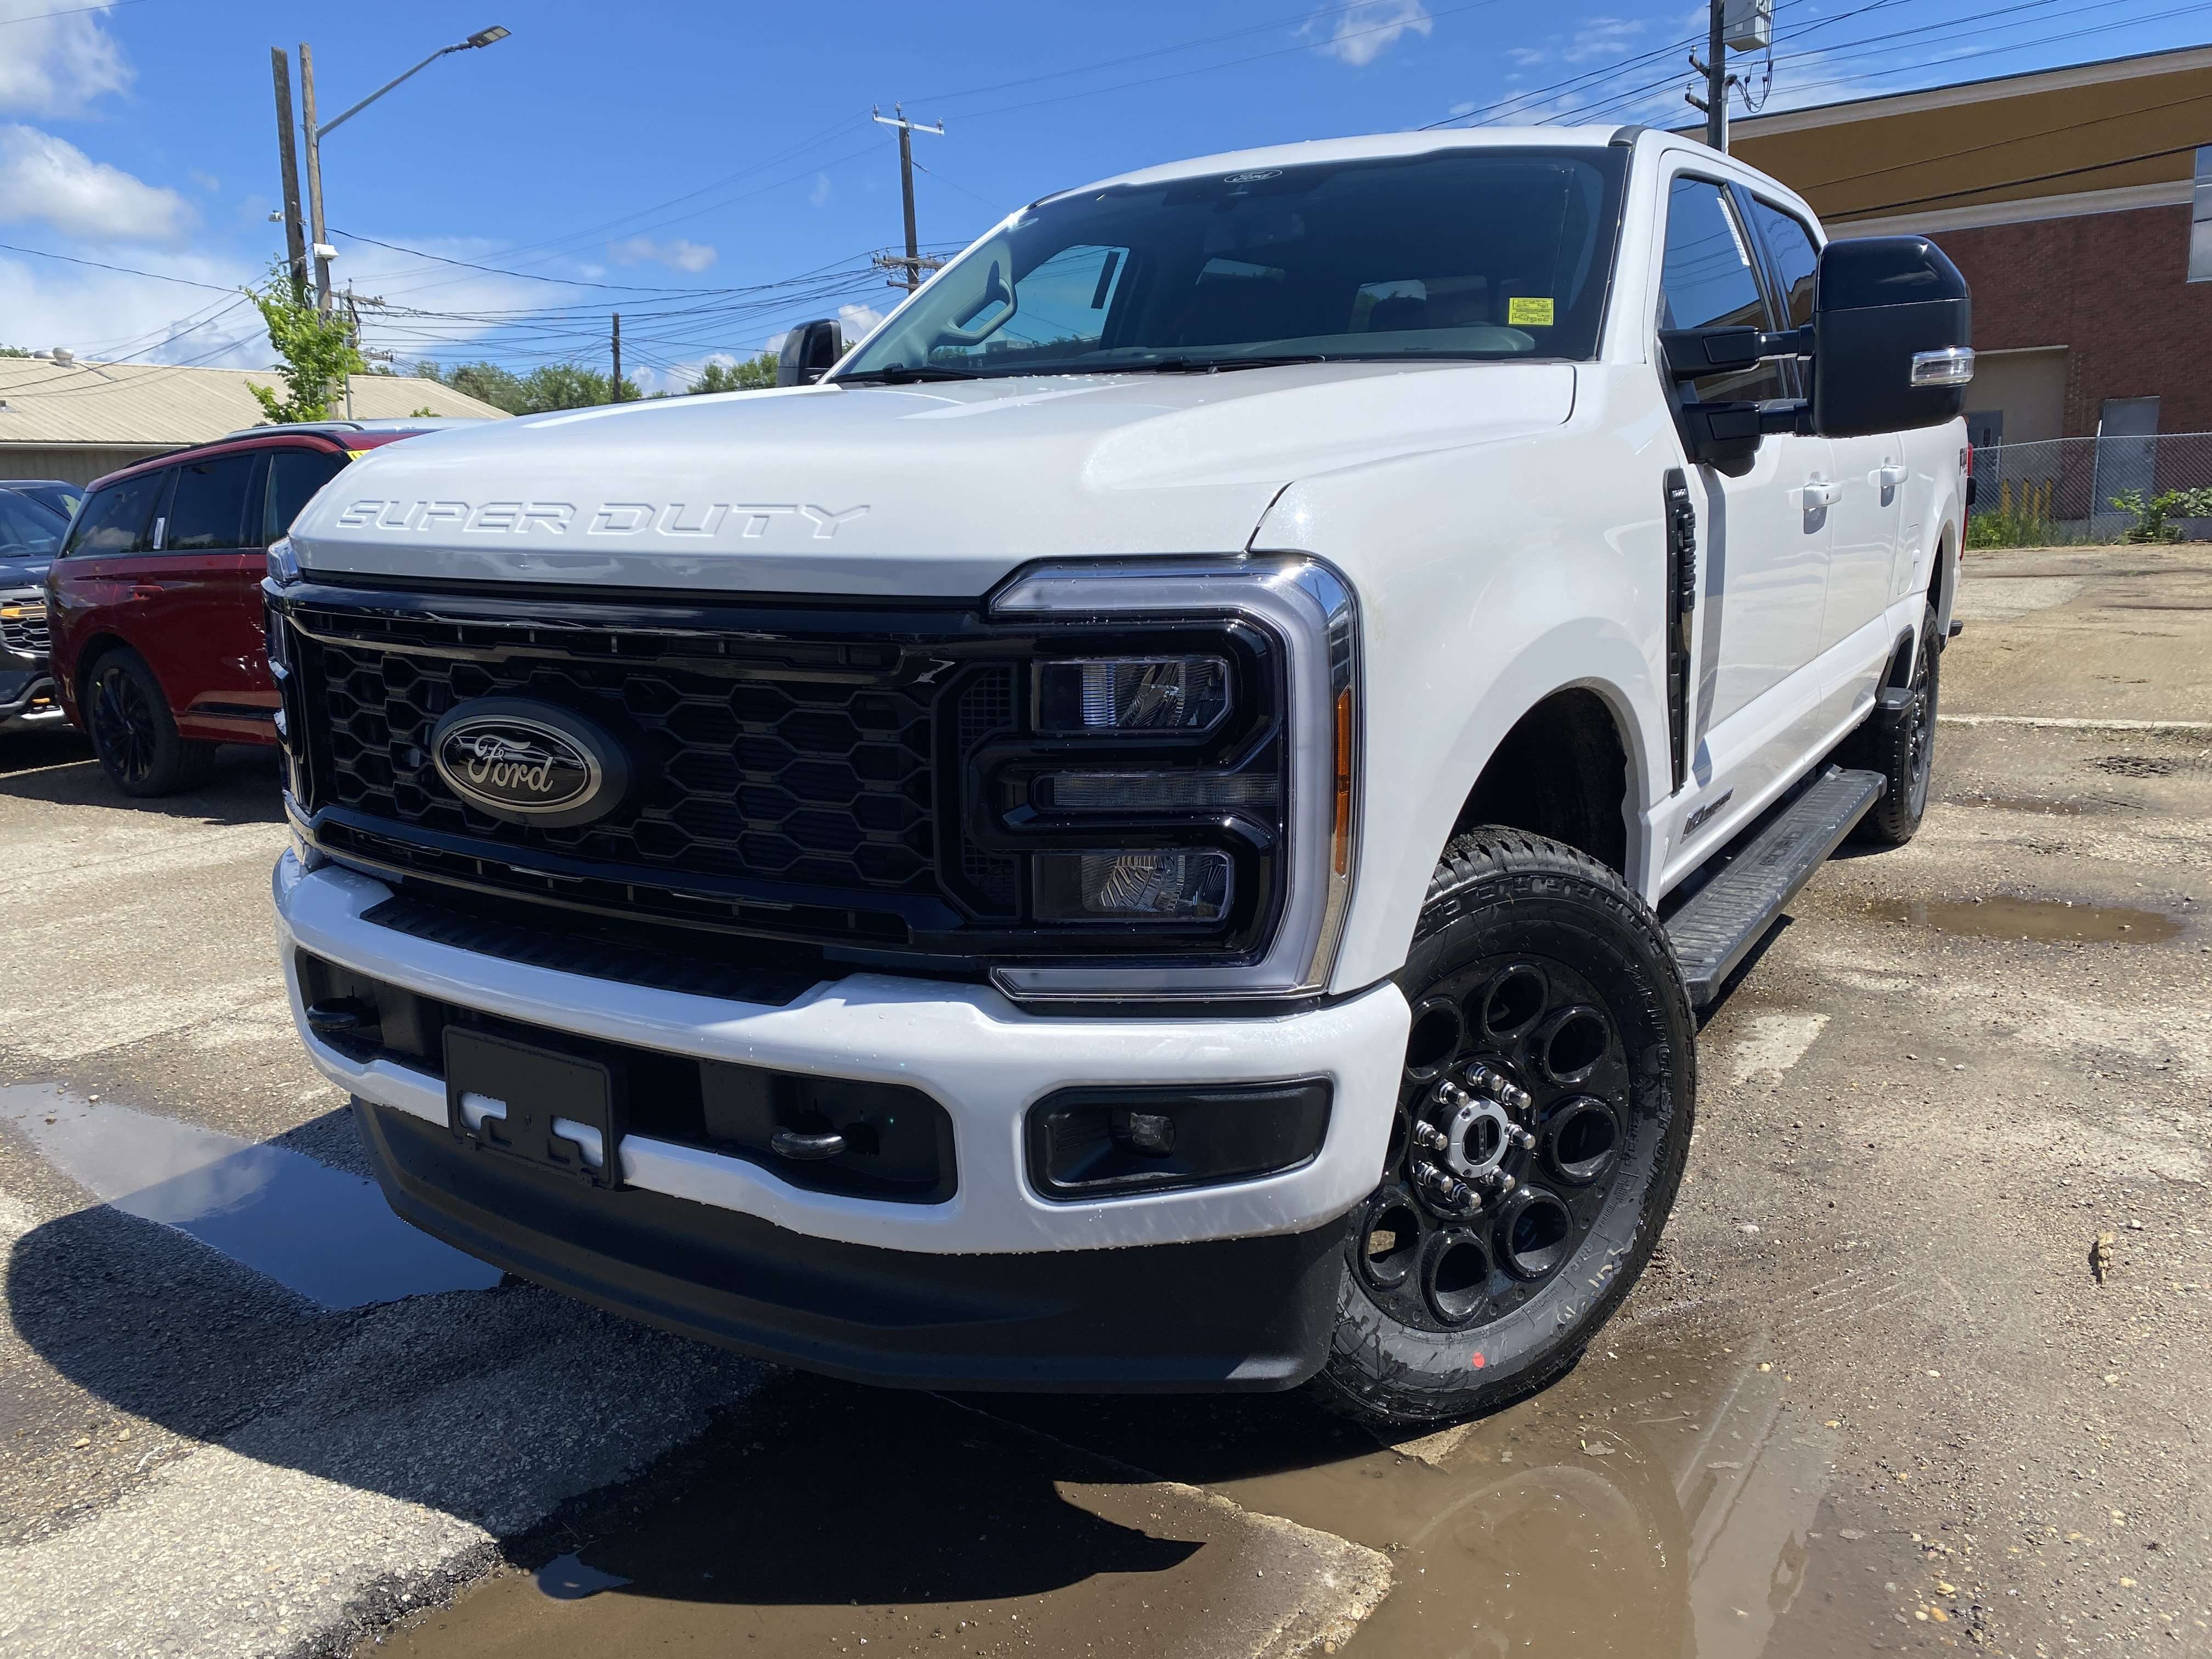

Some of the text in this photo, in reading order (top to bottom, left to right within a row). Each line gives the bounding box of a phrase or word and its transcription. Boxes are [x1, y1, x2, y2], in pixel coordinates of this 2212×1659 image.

[1232, 171, 1273, 181] Ford
[336, 500, 871, 539] SUPER DUTY
[467, 734, 554, 792] Ford
